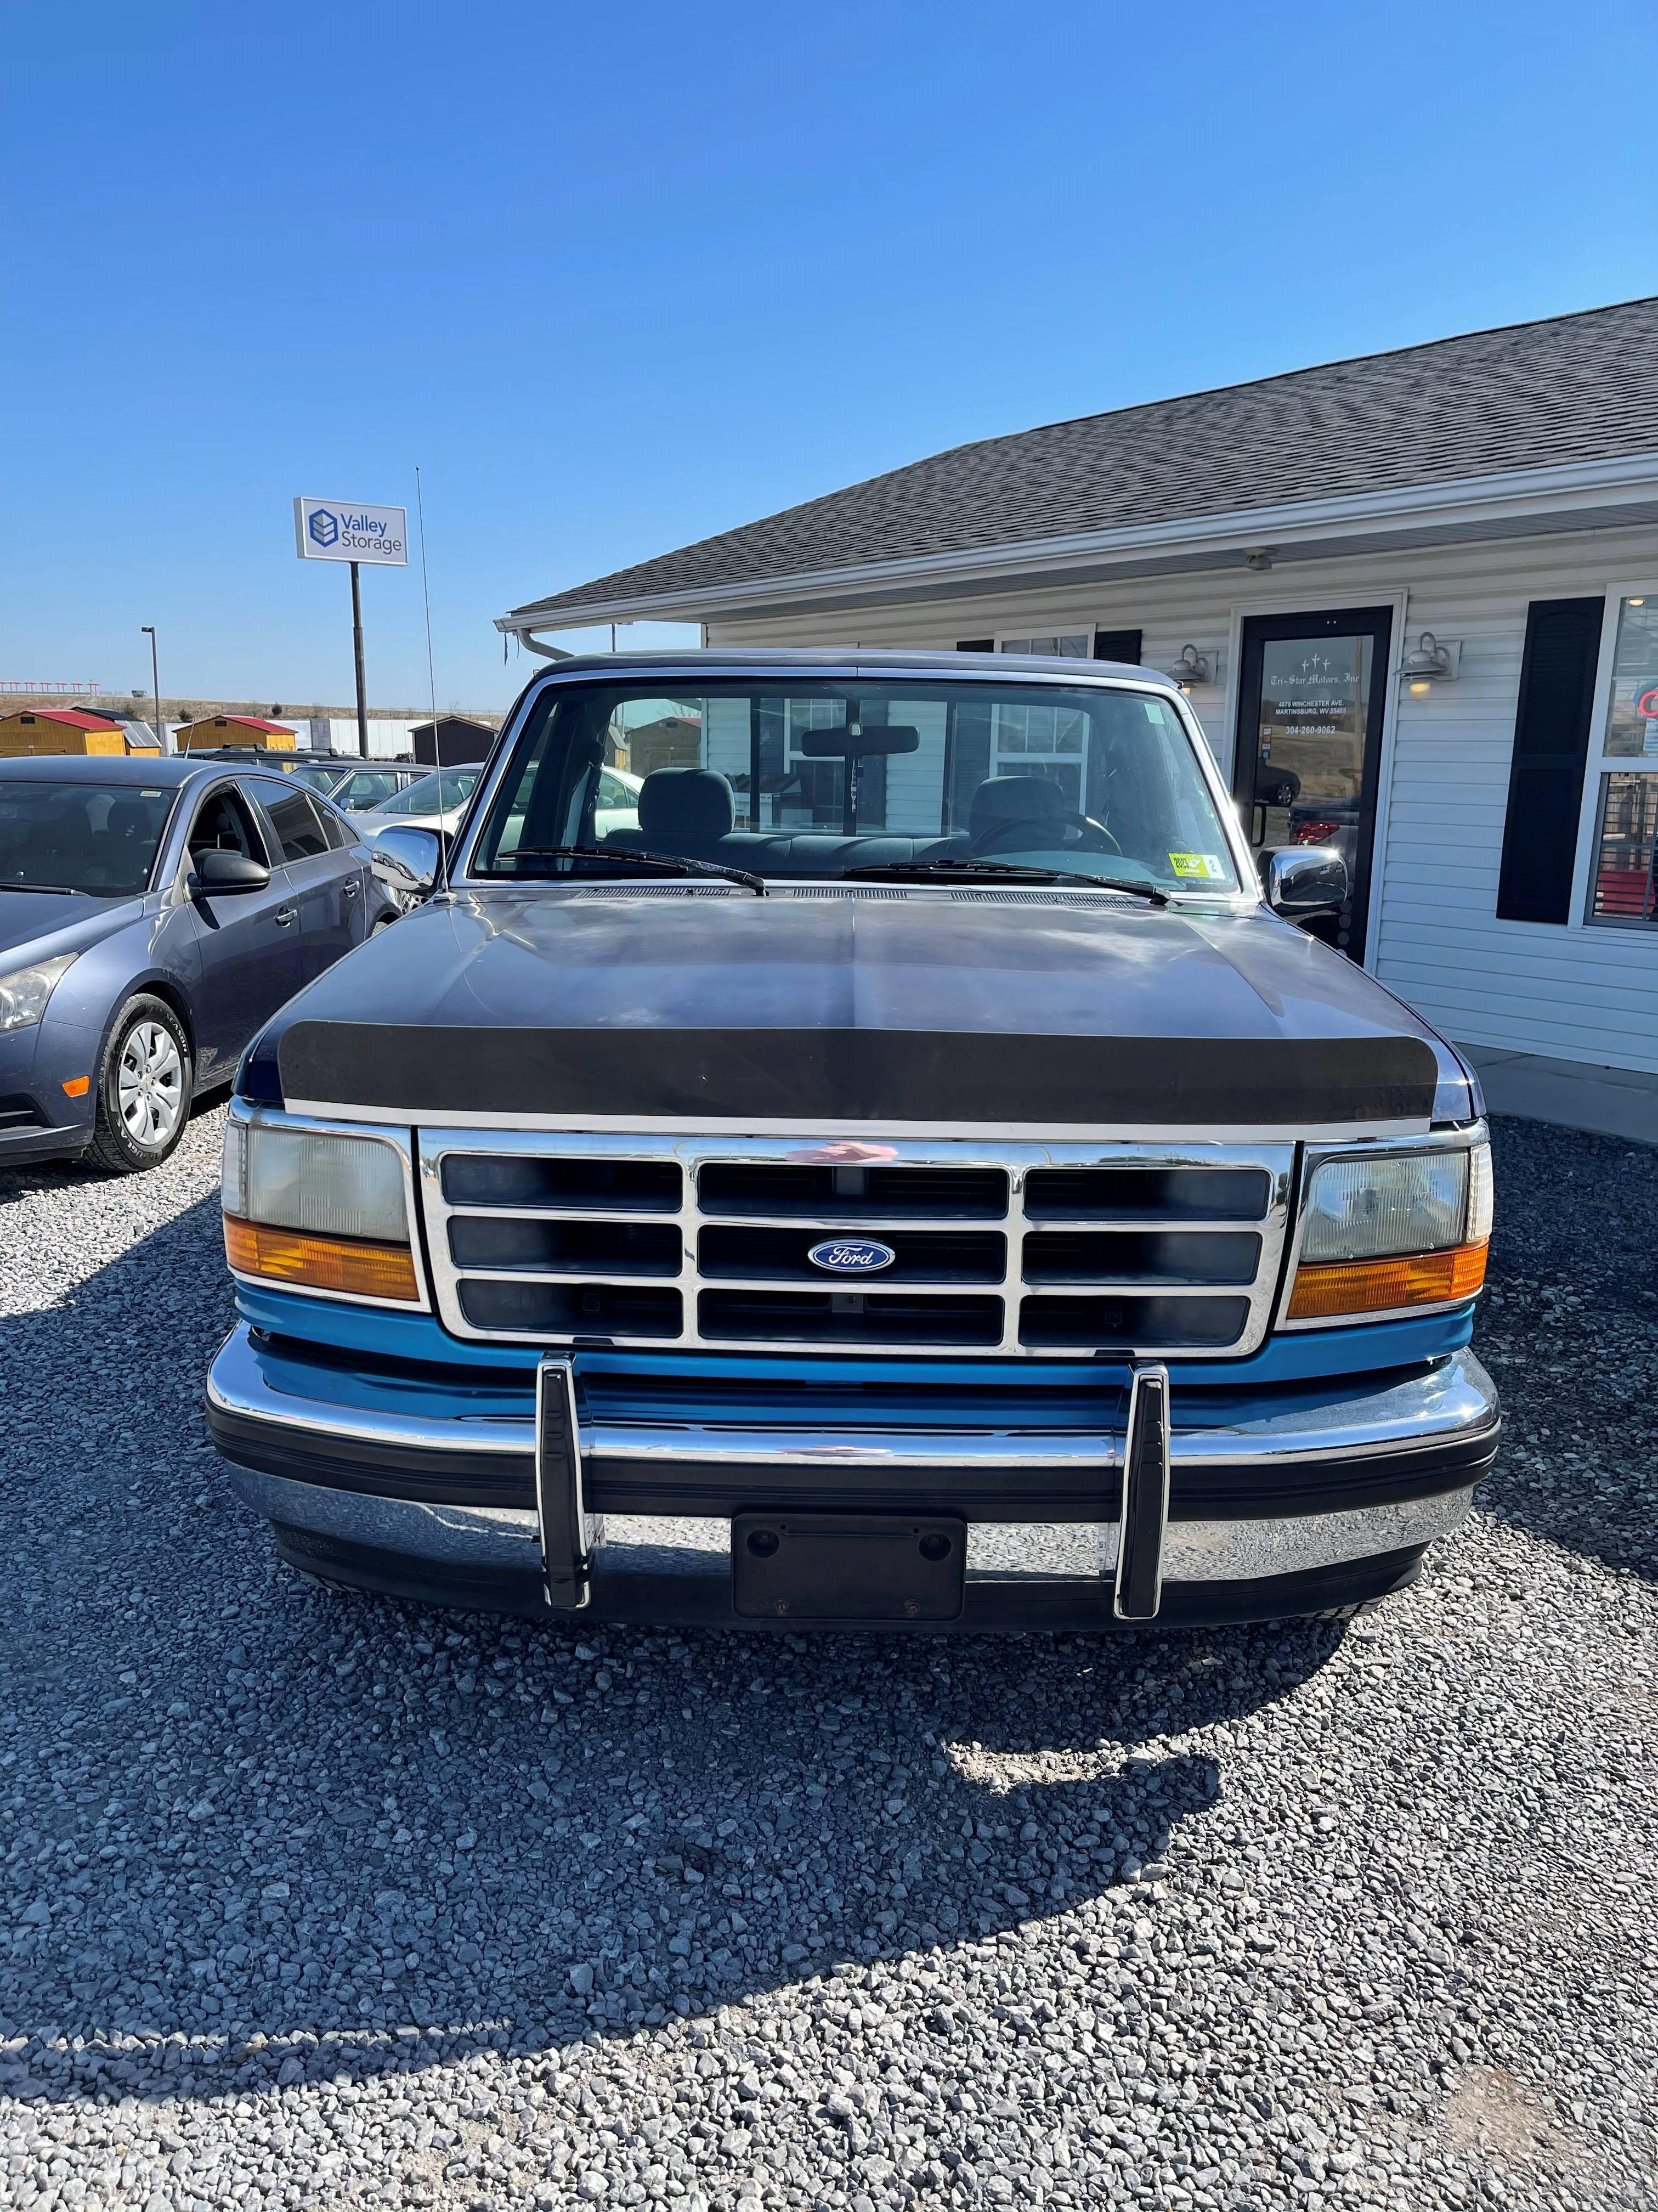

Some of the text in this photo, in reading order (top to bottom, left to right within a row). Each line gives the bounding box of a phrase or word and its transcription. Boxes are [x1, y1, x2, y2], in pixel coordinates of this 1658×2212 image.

[340, 513, 387, 538] Valley
[342, 531, 401, 555] Storage
[1270, 674, 1306, 685] Tri-Star
[1285, 725, 1336, 734] 304-260-9062
[1209, 860, 1216, 872] 2
[829, 1246, 874, 1265] Ford
